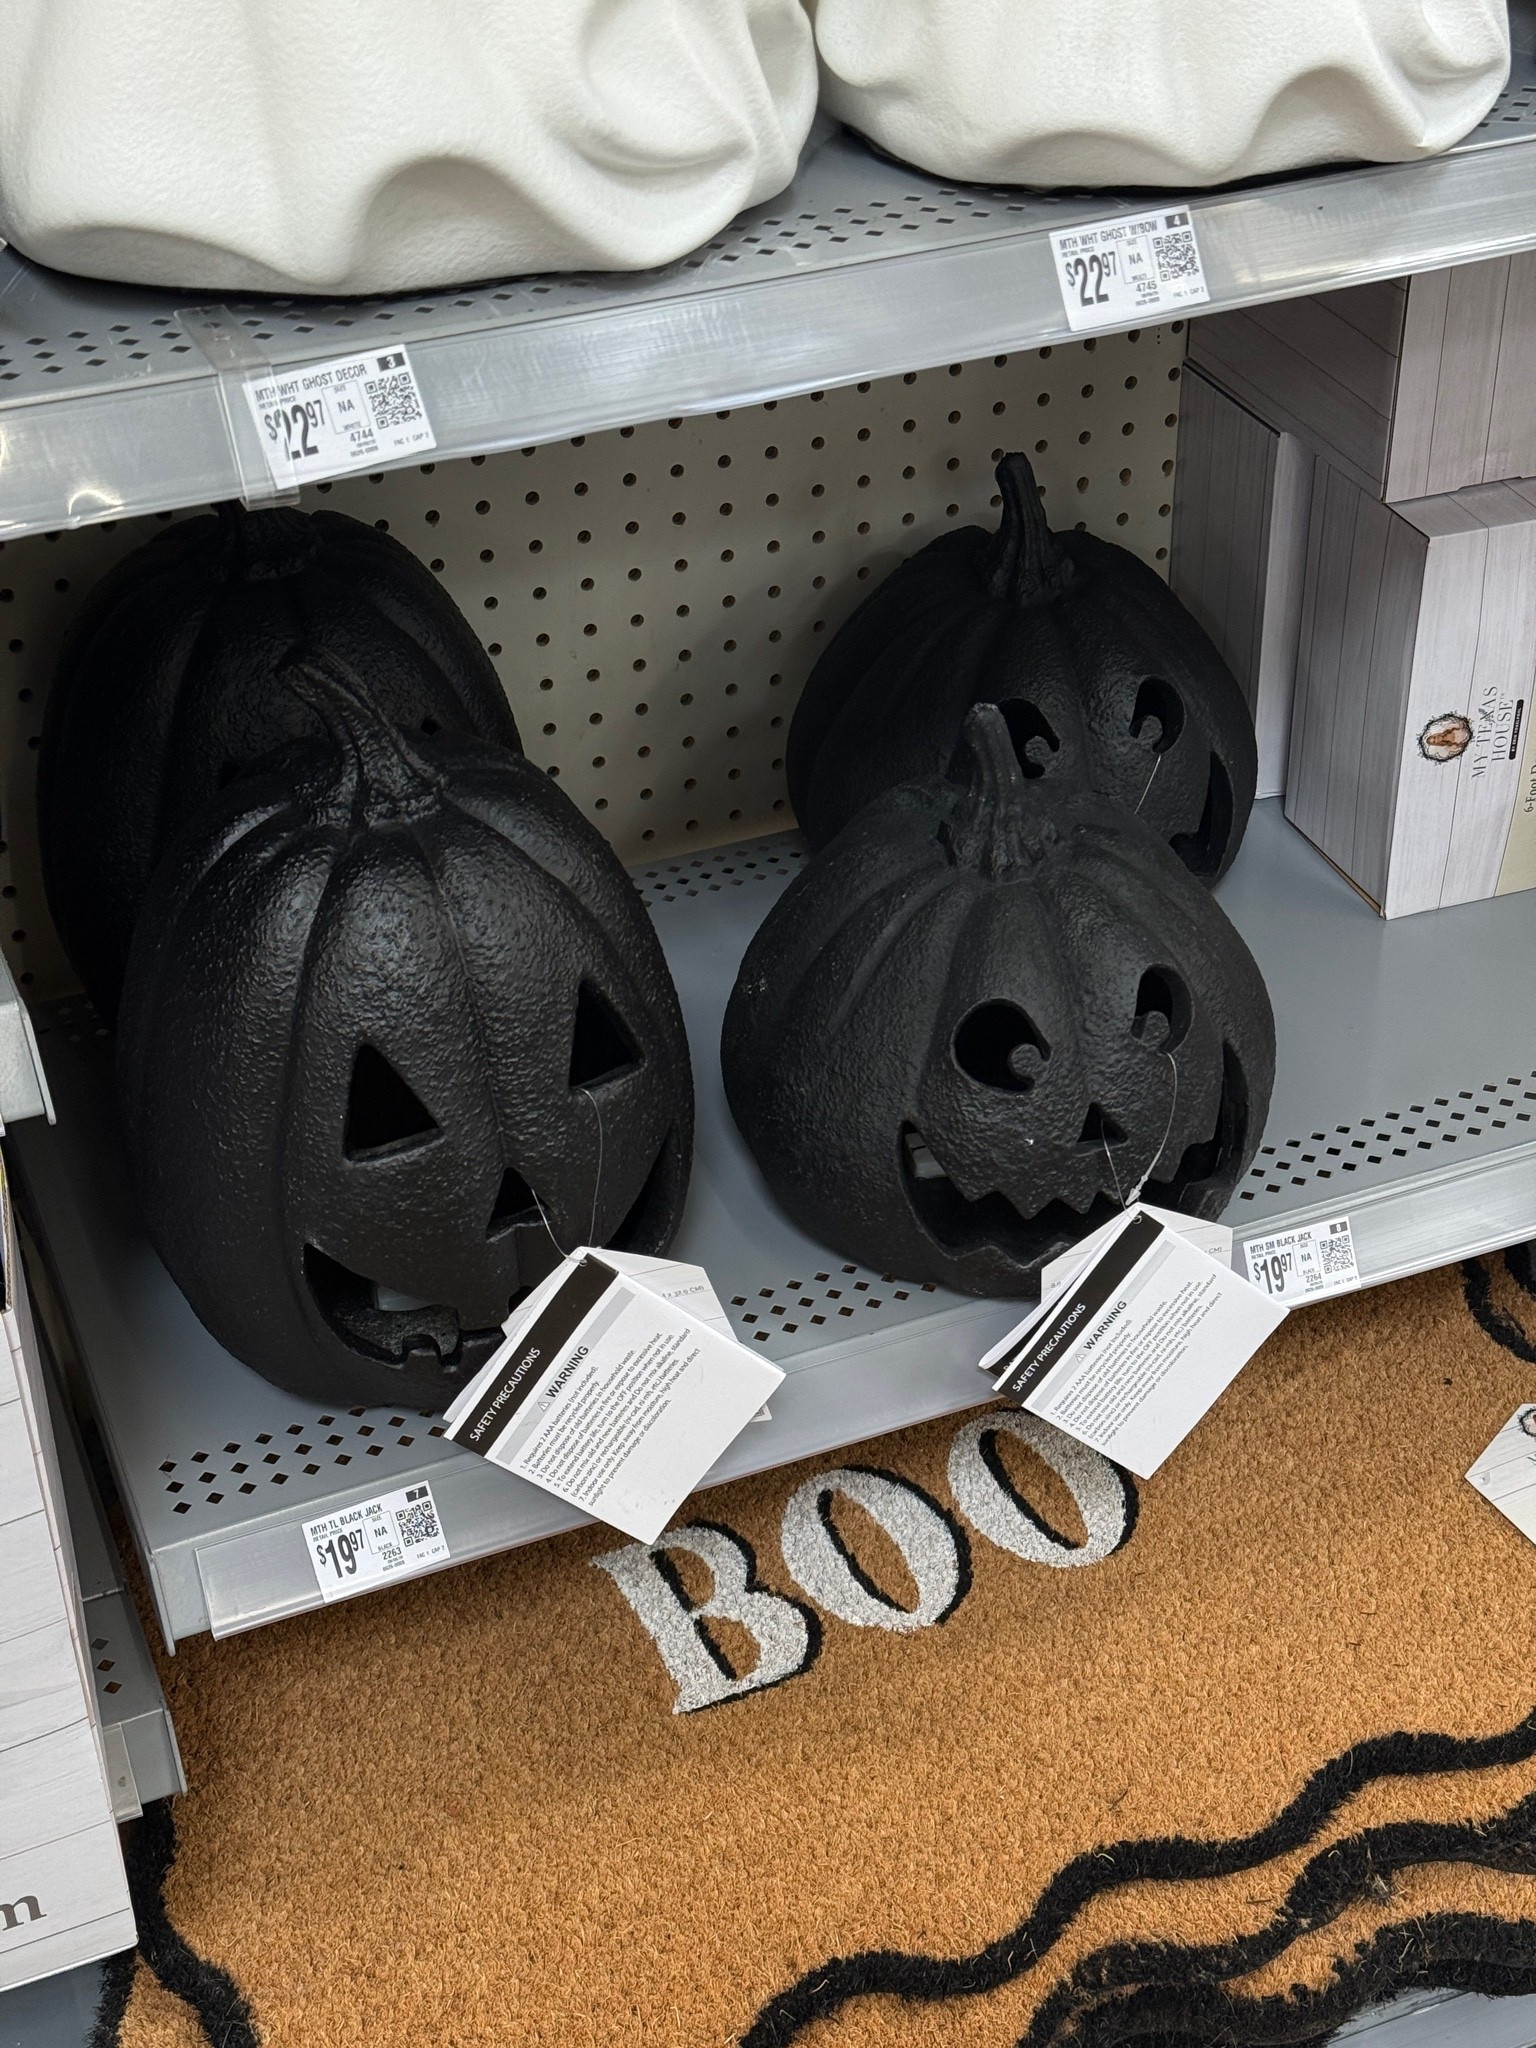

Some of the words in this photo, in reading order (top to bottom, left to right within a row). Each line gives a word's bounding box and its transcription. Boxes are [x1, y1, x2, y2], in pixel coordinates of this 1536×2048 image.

[1059, 237, 1078, 250] MTH
[1079, 232, 1098, 246] WHT
[1100, 226, 1127, 242] GHOST
[1174, 215, 1181, 225] 4
[1128, 252, 1143, 265] NA
[1136, 280, 1157, 292] 4745
[386, 356, 396, 368] 3
[254, 386, 276, 402] MTH
[277, 380, 299, 396] WHT
[302, 371, 333, 390] GHOST
[335, 363, 367, 382] DECOR
[337, 399, 355, 413] NA
[350, 428, 374, 442] 4744
[1476, 686, 1498, 747] TEXAS
[1492, 699, 1514, 761] HOUSE
[1472, 754, 1488, 778] MY
[1250, 1244, 1264, 1254] MTH
[1265, 1241, 1275, 1250] SM
[1276, 1236, 1296, 1247] BLACK
[1297, 1231, 1312, 1242] JACK
[1301, 1253, 1312, 1262] NA
[1305, 1272, 1321, 1283] 2264
[1083, 1301, 1127, 1350] WARNING
[1012, 1360, 1039, 1392] SAFETY
[1037, 1303, 1086, 1361] PRECAUTIONS
[545, 1346, 589, 1398] WARNING
[470, 1407, 497, 1441] SAFETY
[492, 1347, 540, 1409] PRECAUTIONS
[556, 1459, 566, 1469] not
[563, 1439, 580, 1460] dispose
[580, 1410, 601, 1434] batteries
[601, 1396, 612, 1406] fire
[614, 1372, 630, 1390] expose
[633, 1344, 653, 1367] excessive
[564, 1455, 580, 1475] extend
[575, 1437, 594, 1457] battery
[597, 1416, 609, 1429] turn
[610, 1401, 620, 1411] the
[617, 1390, 627, 1402] OFF
[625, 1370, 644, 1392] position
[641, 1357, 655, 1371] when
[652, 1348, 662, 1358] not
[573, 1468, 583, 1479] not
[580, 1458, 590, 1469] mix
[587, 1448, 597, 1459] old
[594, 1437, 604, 1450] and
[601, 1427, 612, 1439] new
[609, 1404, 629, 1428] batteries
[627, 1393, 637, 1405] and
[641, 1377, 651, 1387] not
[648, 1368, 658, 1379] mix
[671, 1328, 691, 1351] standard
[600, 1424, 627, 1457] rechargeable
[658, 1359, 679, 1380] batteries.
[523, 1441, 543, 1465] Requires
[543, 1425, 555, 1438] AAA
[551, 1402, 572, 1426] batteries
[568, 1390, 580, 1403] (not
[547, 1454, 557, 1465] not
[554, 1435, 572, 1455] dispose
[574, 1418, 583, 1429] old
[579, 1397, 599, 1420] batteries
[599, 1363, 624, 1392] household
[582, 1477, 598, 1496] Indoor
[596, 1468, 606, 1478] use
[611, 1442, 625, 1456] Keep
[623, 1428, 636, 1443] away
[632, 1416, 645, 1429] from
[642, 1394, 664, 1417] moisture,
[659, 1382, 672, 1394] high
[668, 1371, 681, 1383] heat
[678, 1361, 689, 1372] and
[686, 1348, 700, 1363] direct
[532, 1446, 552, 1469] Batteries
[549, 1432, 562, 1446] must
[564, 1402, 583, 1425] recycled
[588, 1484, 606, 1507] sunlight
[608, 1457, 626, 1479] prevent
[623, 1436, 641, 1458] damage
[643, 1399, 671, 1431] discoloration.
[413, 1489, 419, 1498] 7
[310, 1523, 328, 1536] MTH
[328, 1519, 339, 1529] TL
[339, 1510, 363, 1525] BLACK
[365, 1503, 383, 1517] JACK
[374, 1526, 388, 1537] NA
[378, 1542, 393, 1551] BLACK
[382, 1547, 402, 1560] 2263
[588, 1408, 1138, 1713] BOO
